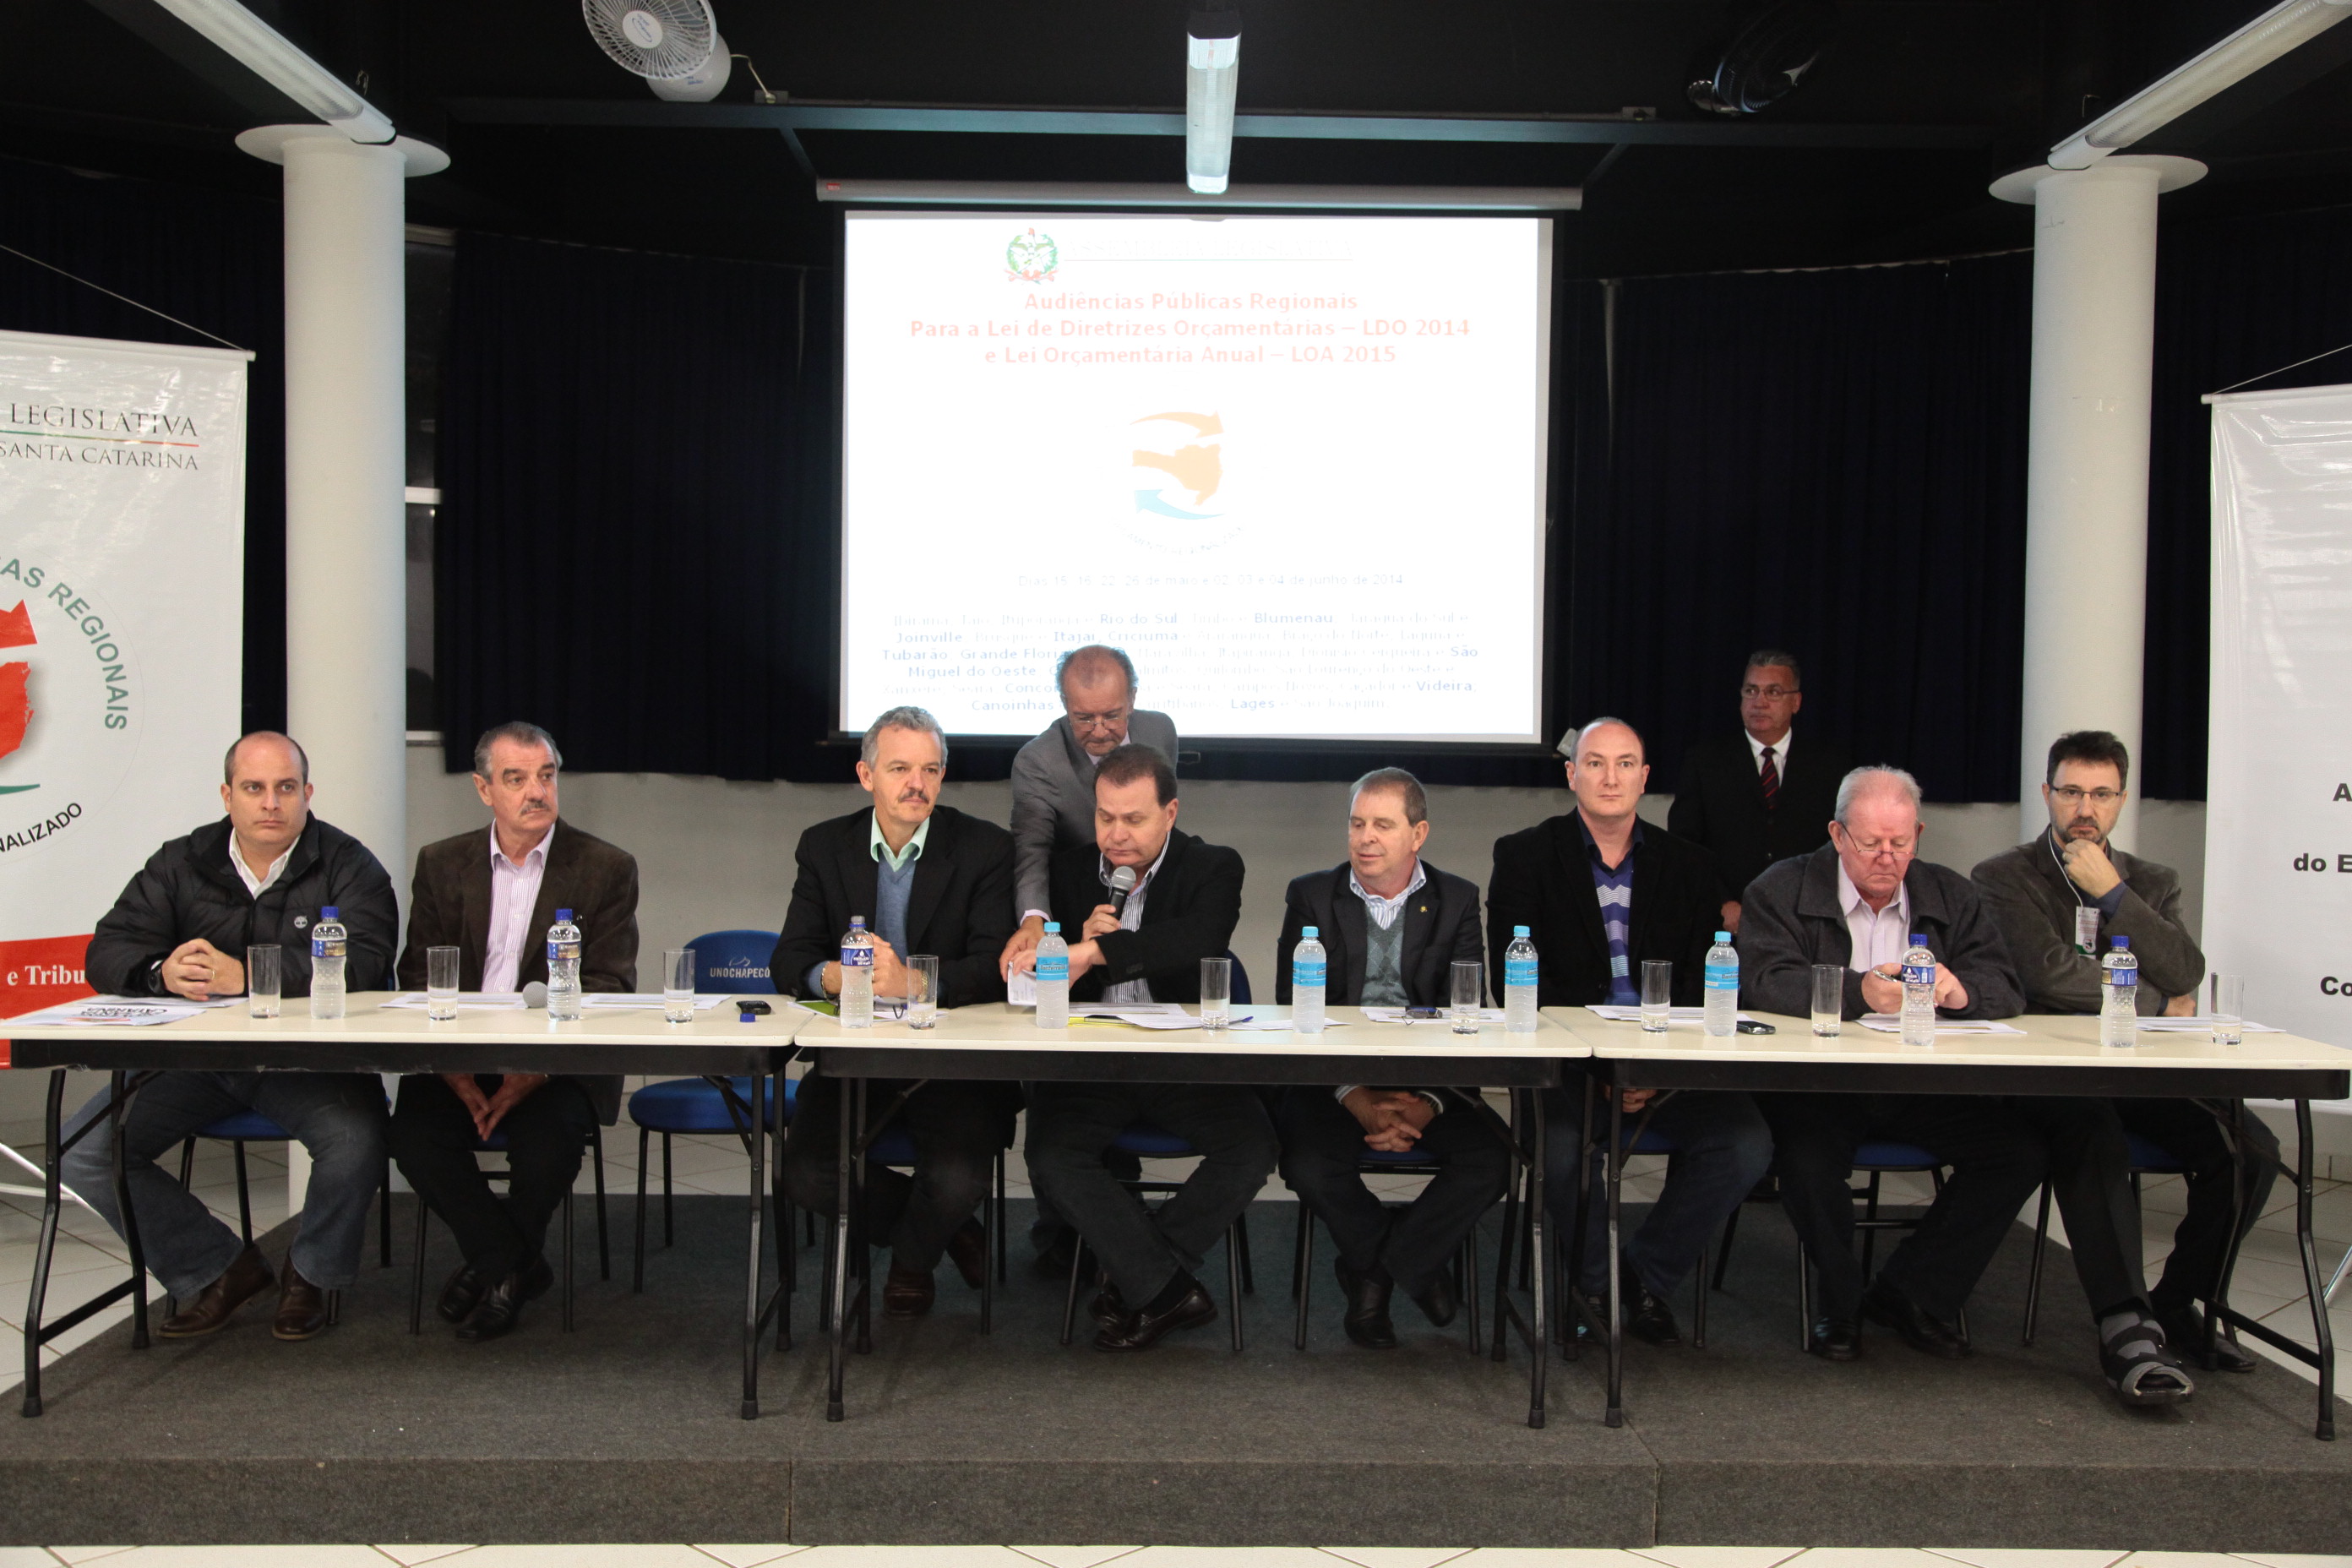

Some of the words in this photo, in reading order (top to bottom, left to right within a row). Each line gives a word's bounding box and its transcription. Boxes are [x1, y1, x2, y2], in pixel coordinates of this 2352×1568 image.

[1025, 291, 1144, 309] Audiências
[1152, 291, 1243, 309] Públicas
[1250, 293, 1358, 313] Regionais
[911, 321, 959, 336] Para
[968, 324, 978, 336] a
[988, 320, 1018, 336] Lei
[1027, 319, 1052, 336] de
[1061, 320, 1166, 336] Diretrizes
[1174, 318, 1335, 339] Orçamentárias
[1364, 319, 1407, 335] LDO
[1416, 319, 1470, 335] 2014
[985, 351, 996, 362] e
[1005, 347, 1036, 362] Lei
[1044, 344, 1193, 365] Orçamentária
[1201, 346, 1263, 362] Anual
[1292, 346, 1334, 362] LOA
[1343, 346, 1396, 362] 2015
[10, 403, 198, 437] LEGISLATIVA
[81, 448, 199, 471] CATARINA
[1100, 614, 1124, 623] Rio
[1130, 613, 1147, 623] do
[47, 581, 128, 730] REGIONAIS
[961, 648, 1018, 659] Grande
[1451, 645, 1478, 657] São
[909, 666, 960, 678] Miguel
[966, 666, 986, 677] do
[972, 700, 1054, 710] Canoinhas
[1231, 700, 1275, 710] Lages
[2293, 852, 2327, 873] do
[7, 971, 19, 986] e
